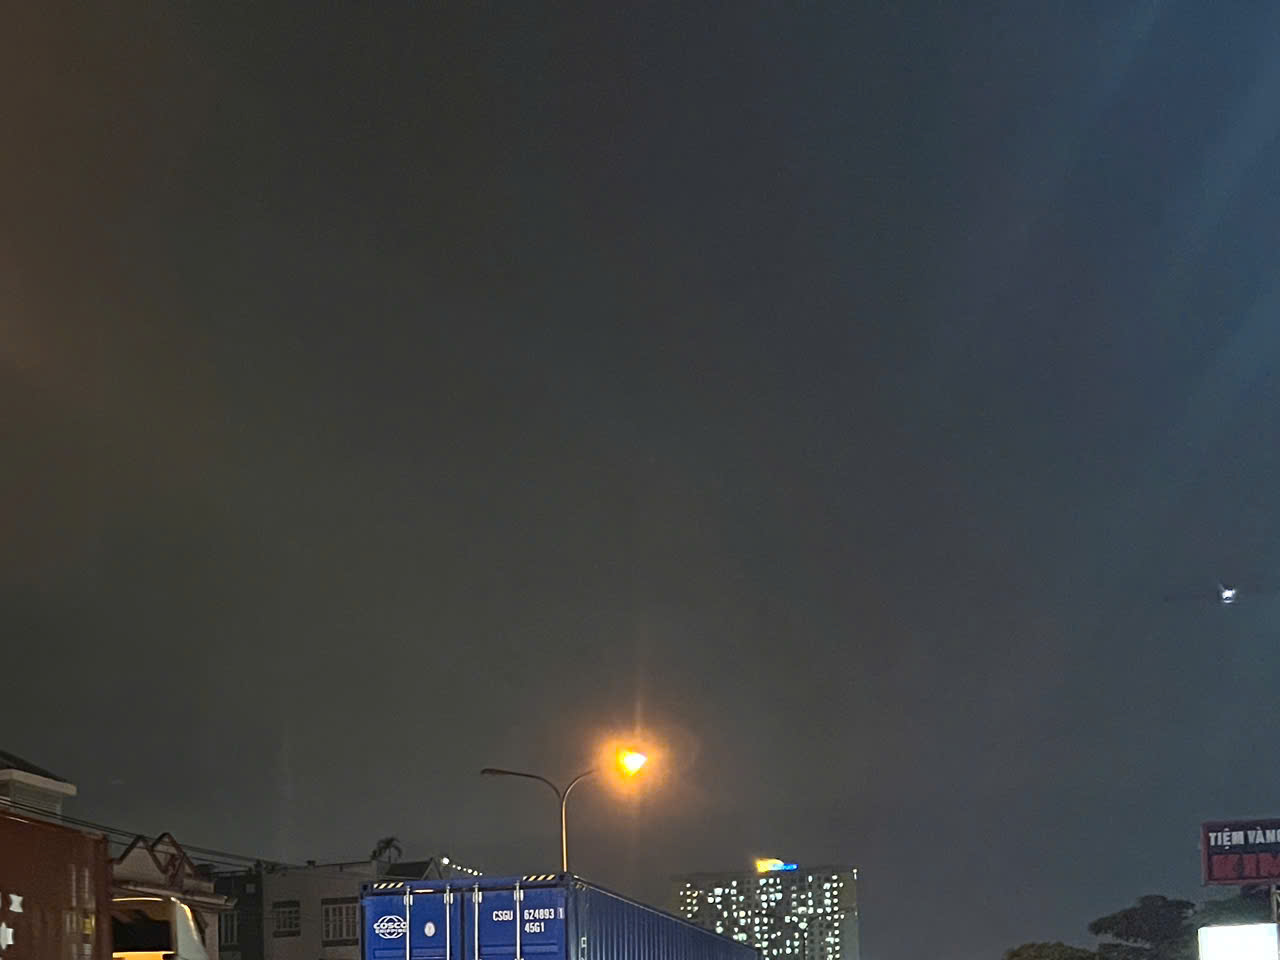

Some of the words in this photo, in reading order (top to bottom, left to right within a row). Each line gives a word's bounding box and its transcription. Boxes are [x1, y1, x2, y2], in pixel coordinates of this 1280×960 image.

[1247, 826, 1280, 845] VÀN
[492, 910, 514, 921] CSGU
[523, 908, 555, 920] 624893
[373, 921, 408, 930] COSCO
[524, 921, 545, 933] 45G1
